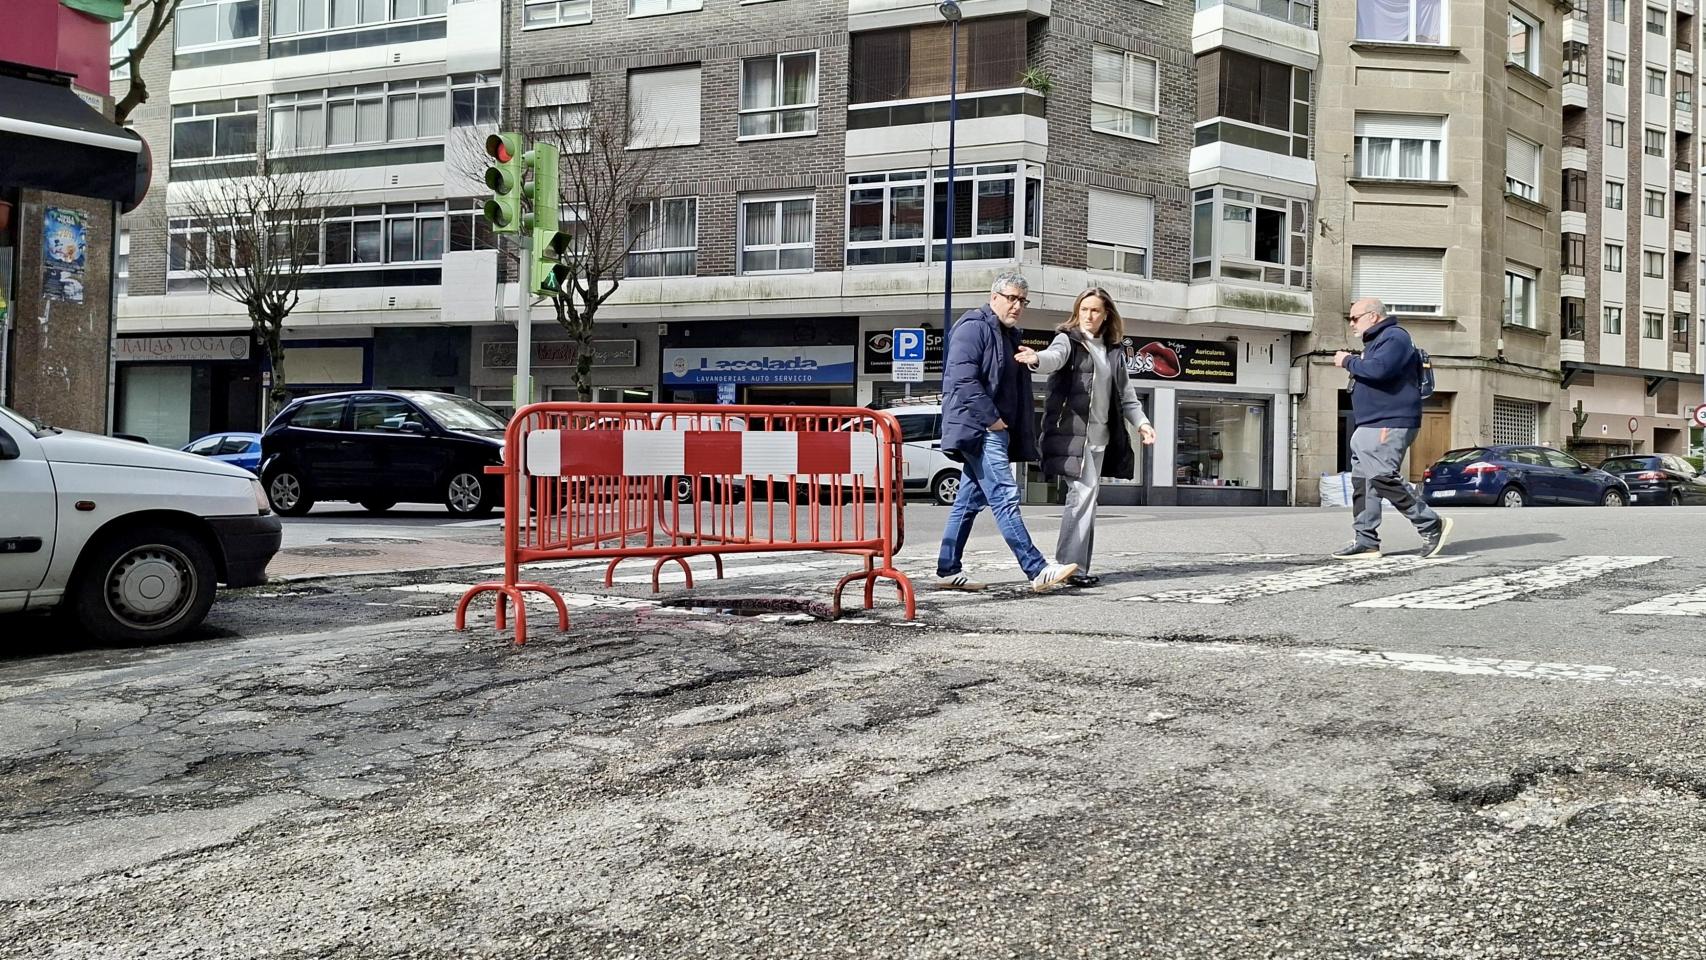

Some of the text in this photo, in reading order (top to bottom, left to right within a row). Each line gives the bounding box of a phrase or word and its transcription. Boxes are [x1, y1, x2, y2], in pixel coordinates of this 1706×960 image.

[180, 337, 226, 352] YOGA
[899, 333, 919, 357] P
[700, 356, 818, 371] Lacolada
[1189, 358, 1231, 366] Complementos
